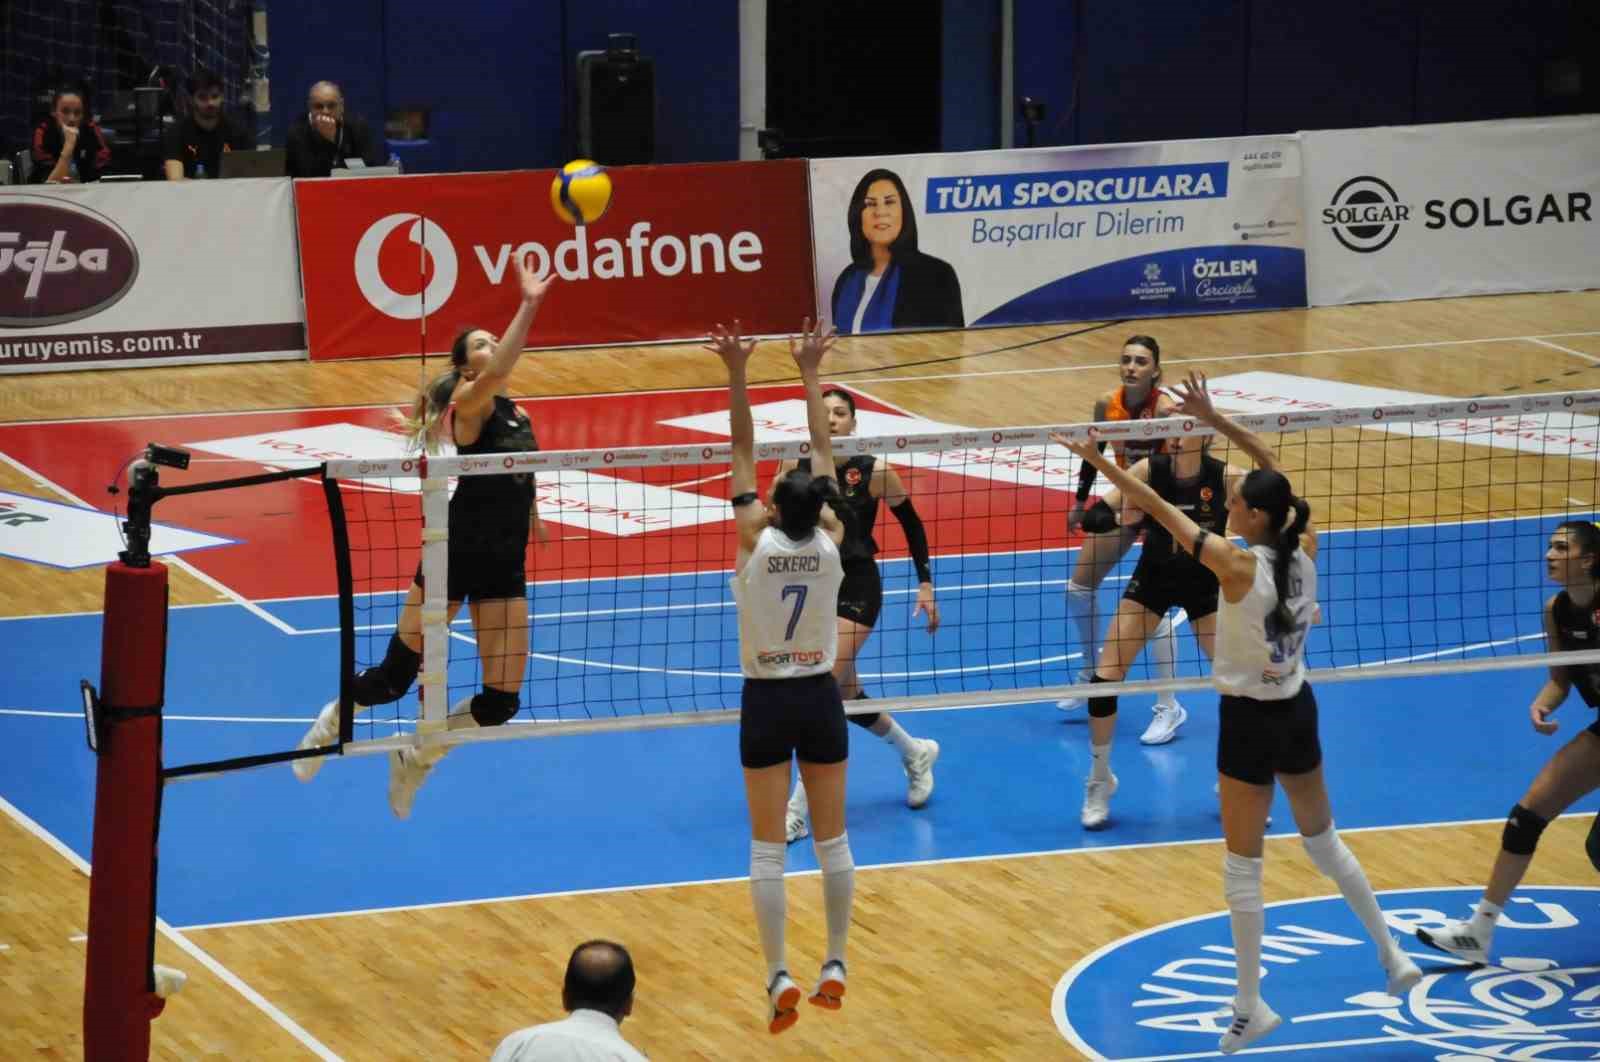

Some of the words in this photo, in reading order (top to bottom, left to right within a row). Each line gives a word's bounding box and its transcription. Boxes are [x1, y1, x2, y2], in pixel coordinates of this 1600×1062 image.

[936, 178, 1002, 209] TÜM
[1012, 172, 1216, 206] SPORCULARA
[971, 211, 1086, 247] Başarılar
[1095, 209, 1185, 237] Dilerim
[1322, 205, 1410, 225] SOLGAR
[1424, 192, 1593, 230] SOLGAR
[473, 222, 763, 285] vodafone
[1193, 257, 1258, 278] ÖZLEM
[782, 584, 808, 642] 7
